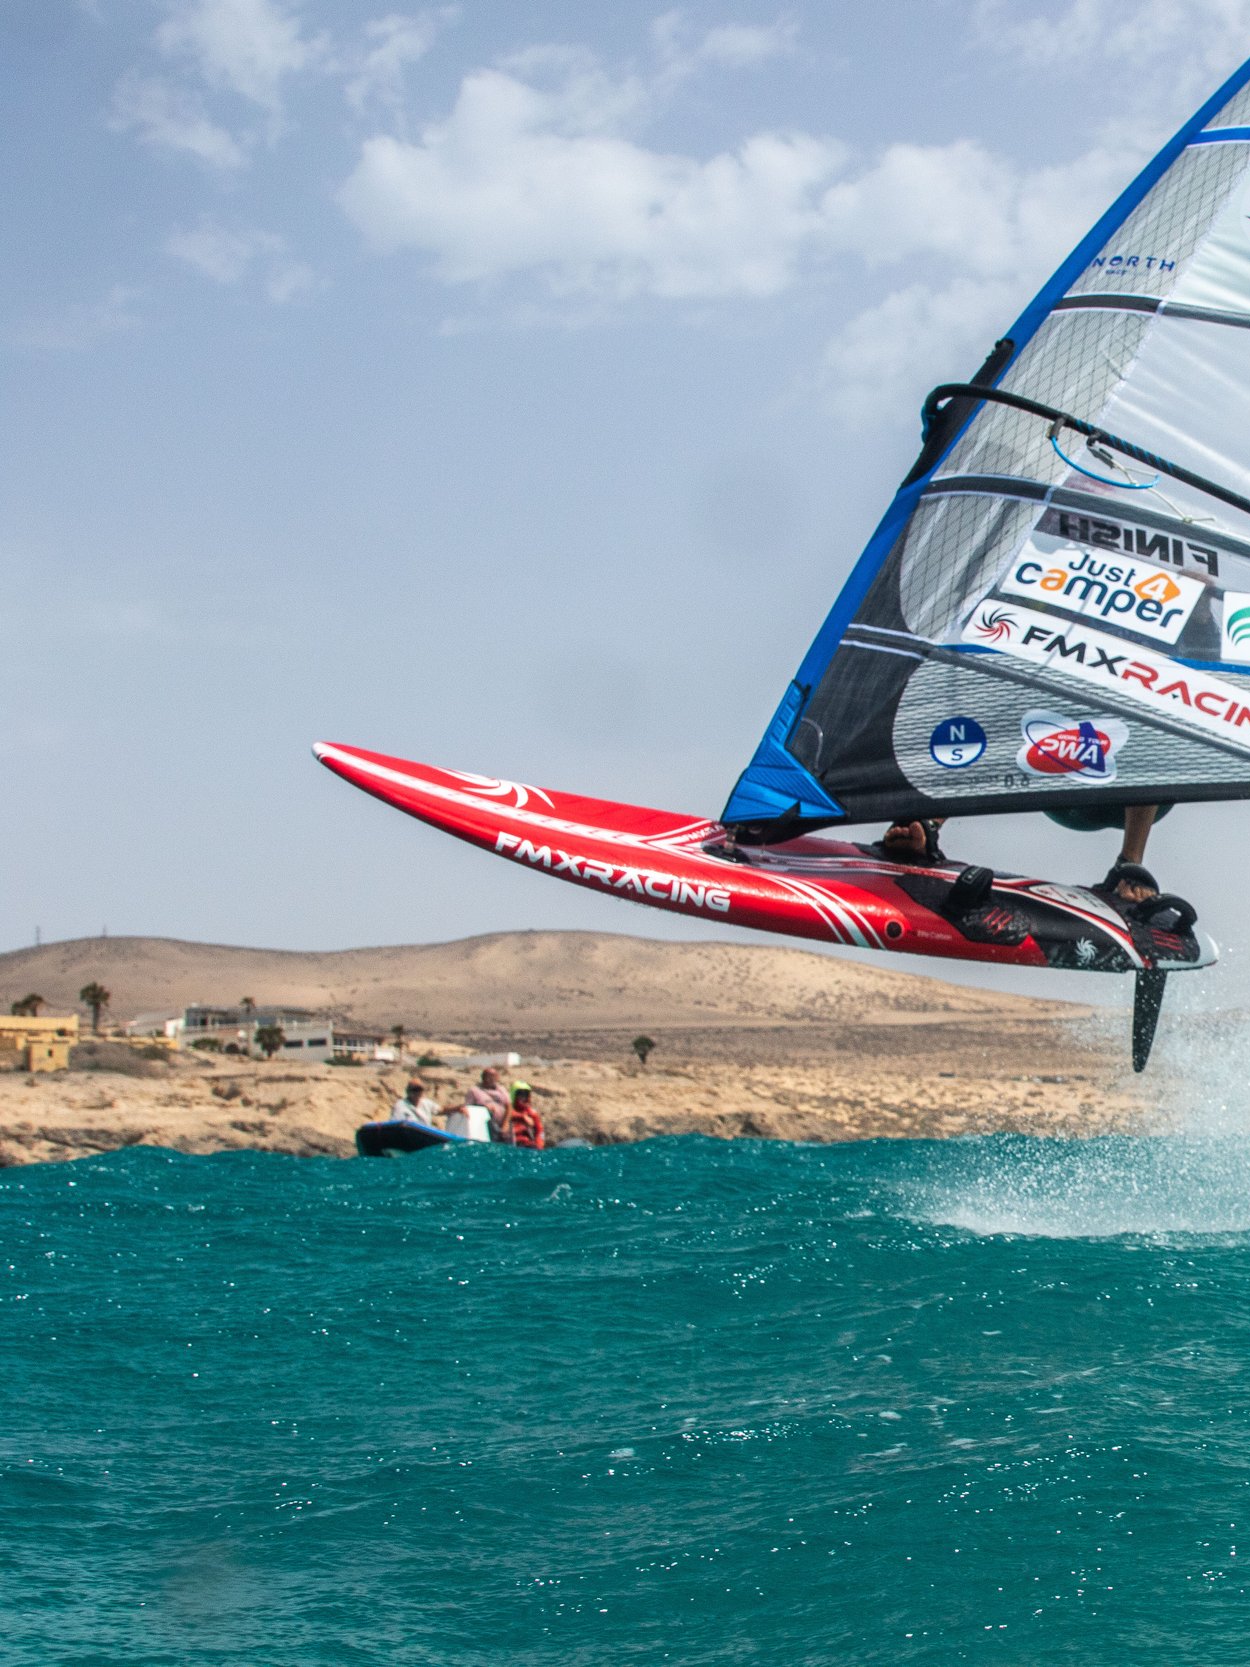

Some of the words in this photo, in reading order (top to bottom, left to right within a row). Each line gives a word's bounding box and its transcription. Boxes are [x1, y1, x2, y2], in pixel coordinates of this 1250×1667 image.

[1092, 255, 1176, 272] NORTH
[1069, 553, 1136, 587] Just
[1142, 579, 1167, 601] 4
[1015, 562, 1184, 628] camper
[950, 725, 965, 741] N
[1058, 733, 1085, 742] WORLD
[951, 749, 964, 761] S
[1038, 738, 1099, 764] PWA
[495, 831, 731, 912] FMXRACING
